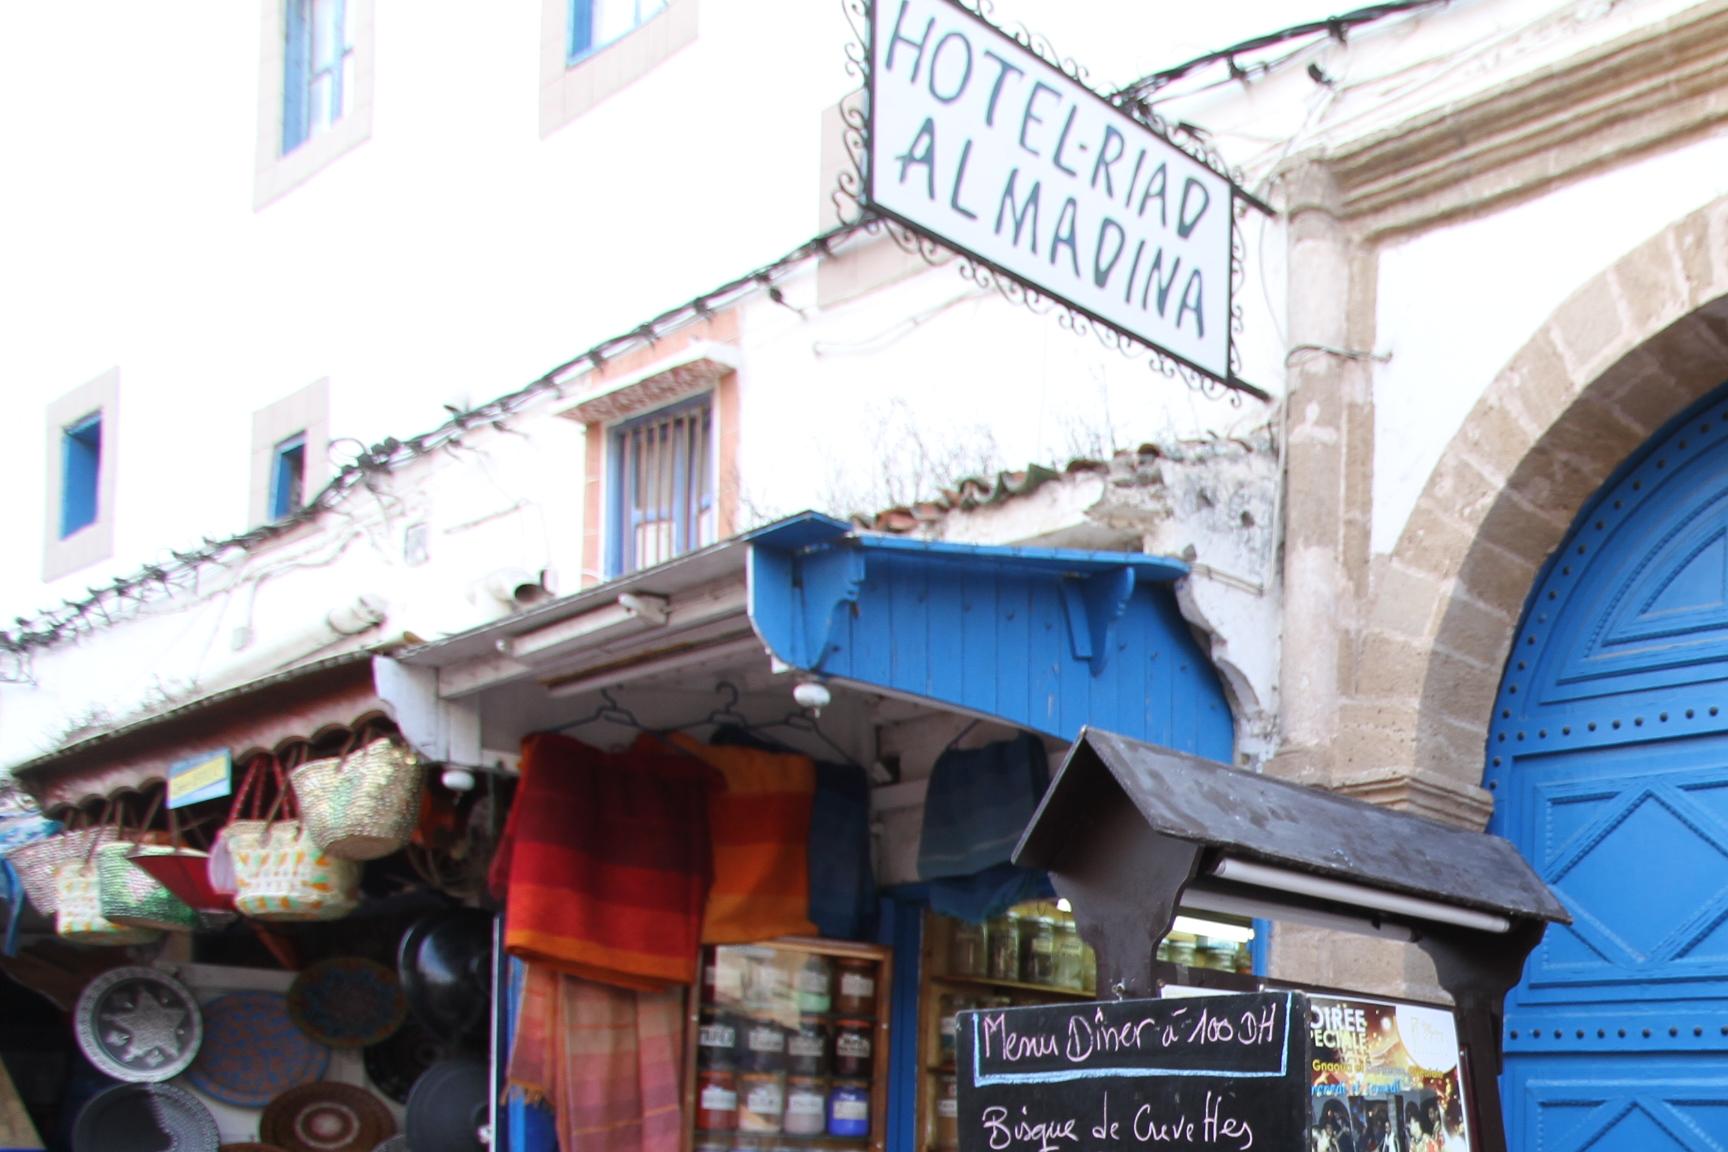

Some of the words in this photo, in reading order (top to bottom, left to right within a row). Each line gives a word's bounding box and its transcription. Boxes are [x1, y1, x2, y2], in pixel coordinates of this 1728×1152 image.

[983, 1010, 1060, 1061] Menu
[1188, 1008, 1233, 1046] 100
[1238, 1003, 1277, 1045] DH
[1311, 1004, 1367, 1033] OIREE
[1092, 1090, 1121, 1141] de
